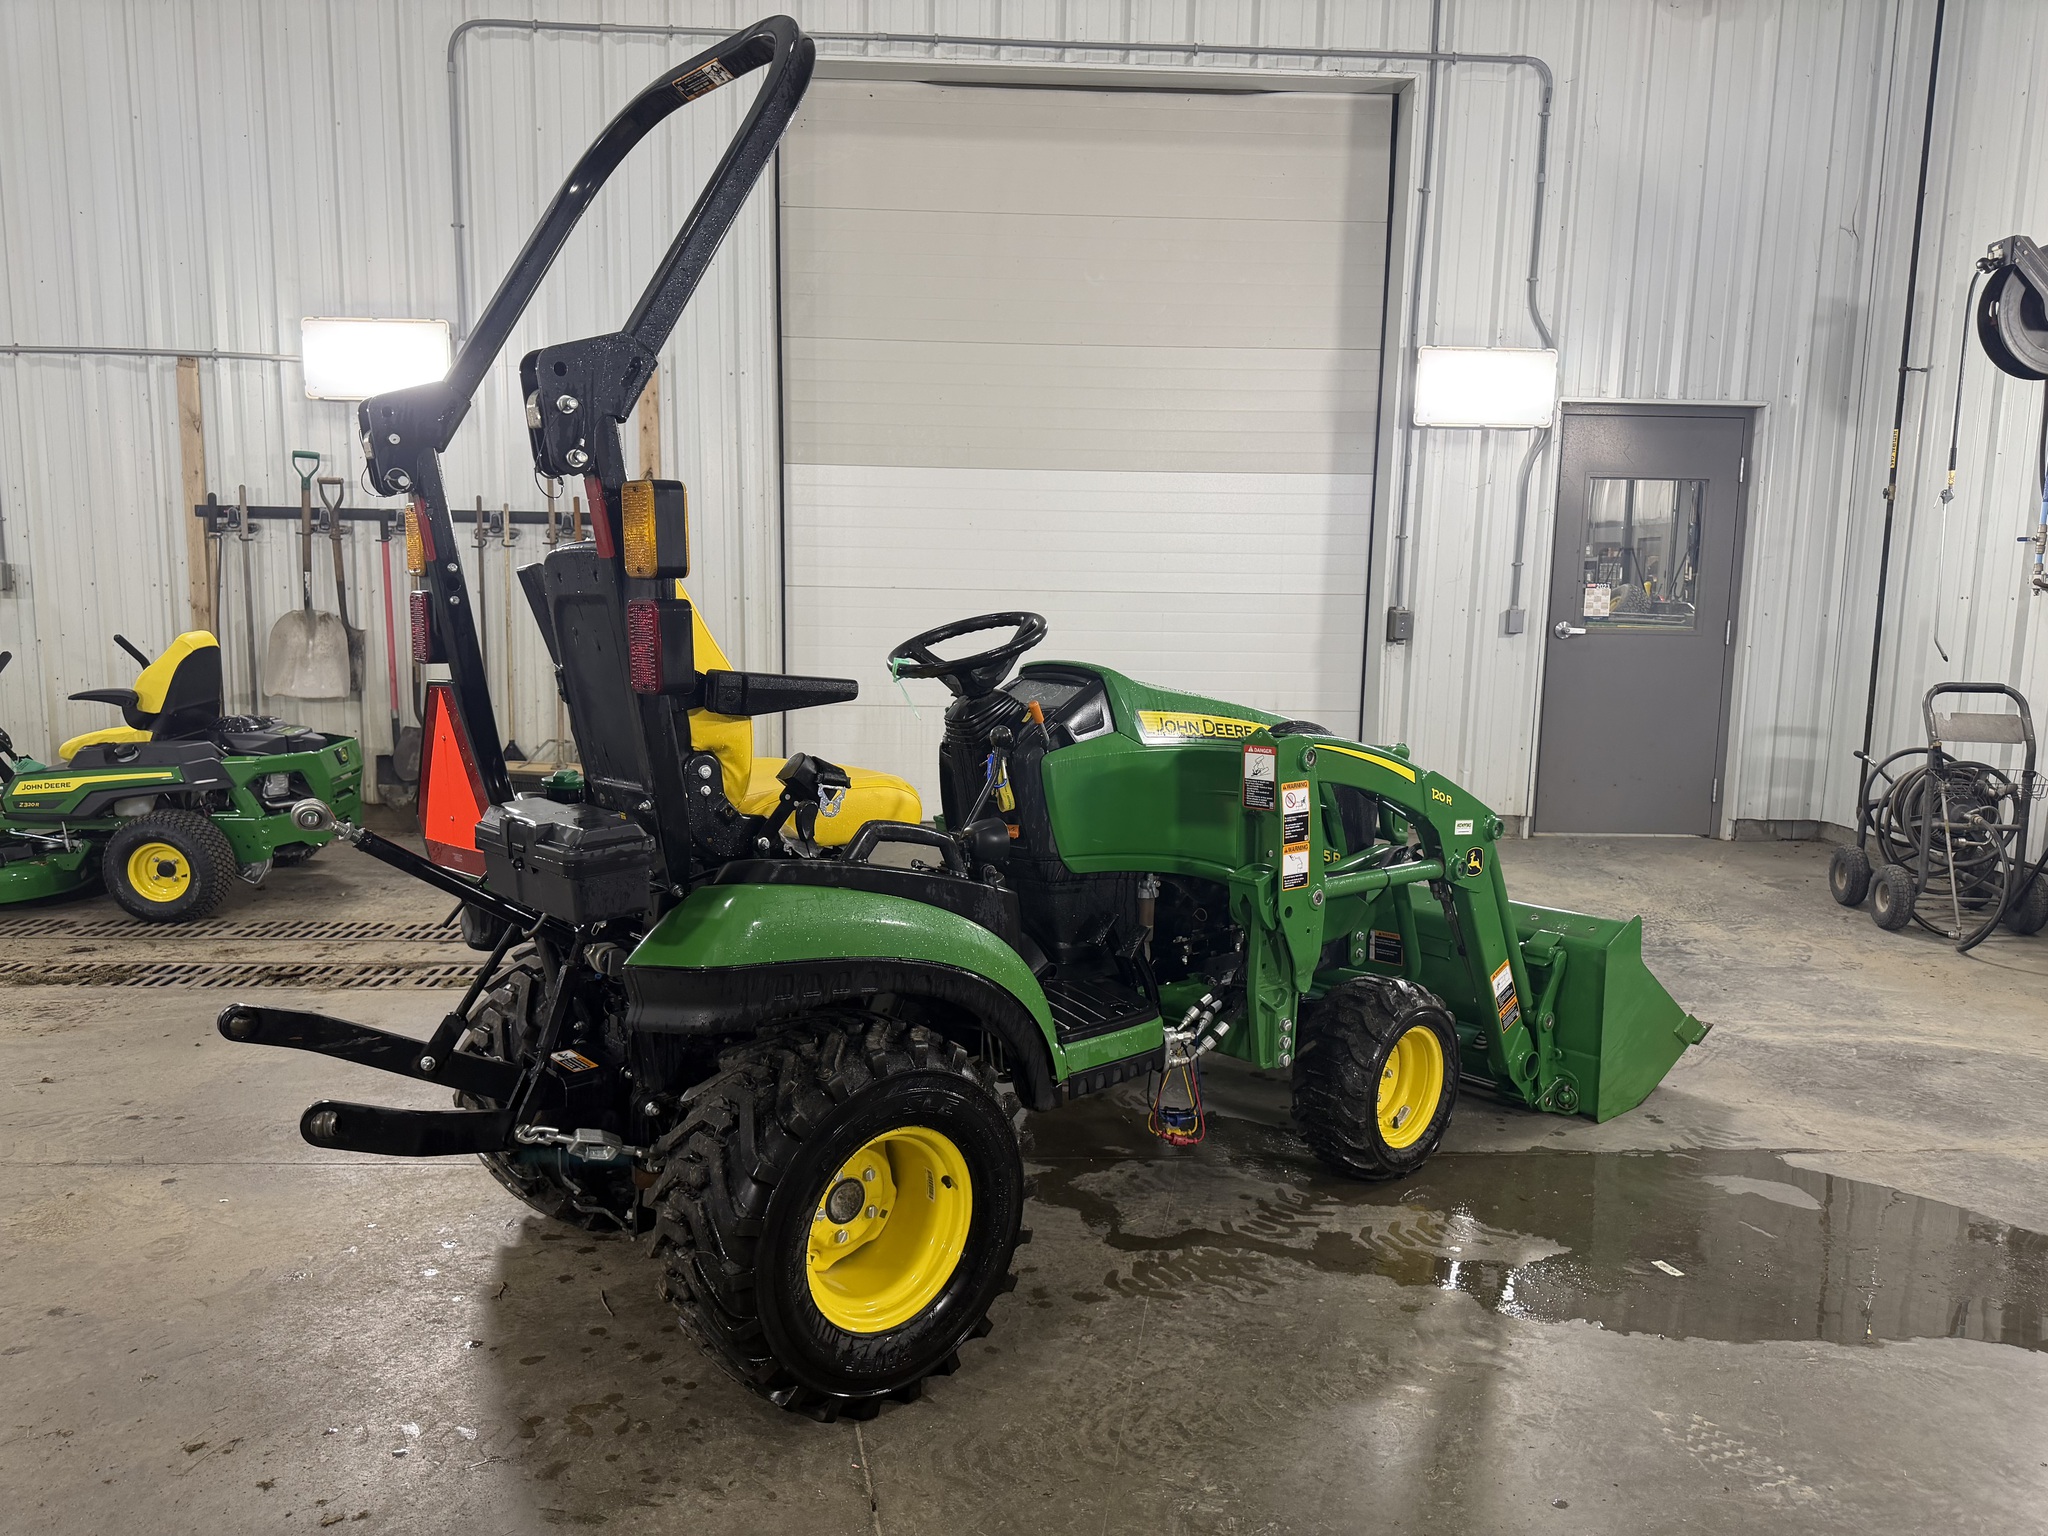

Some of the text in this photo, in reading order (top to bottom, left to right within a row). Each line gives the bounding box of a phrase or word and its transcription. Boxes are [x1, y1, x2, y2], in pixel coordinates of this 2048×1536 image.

[1157, 717, 1200, 736] JOHN
[22, 783, 43, 791] JOHN
[1288, 844, 1309, 853] WARNING
